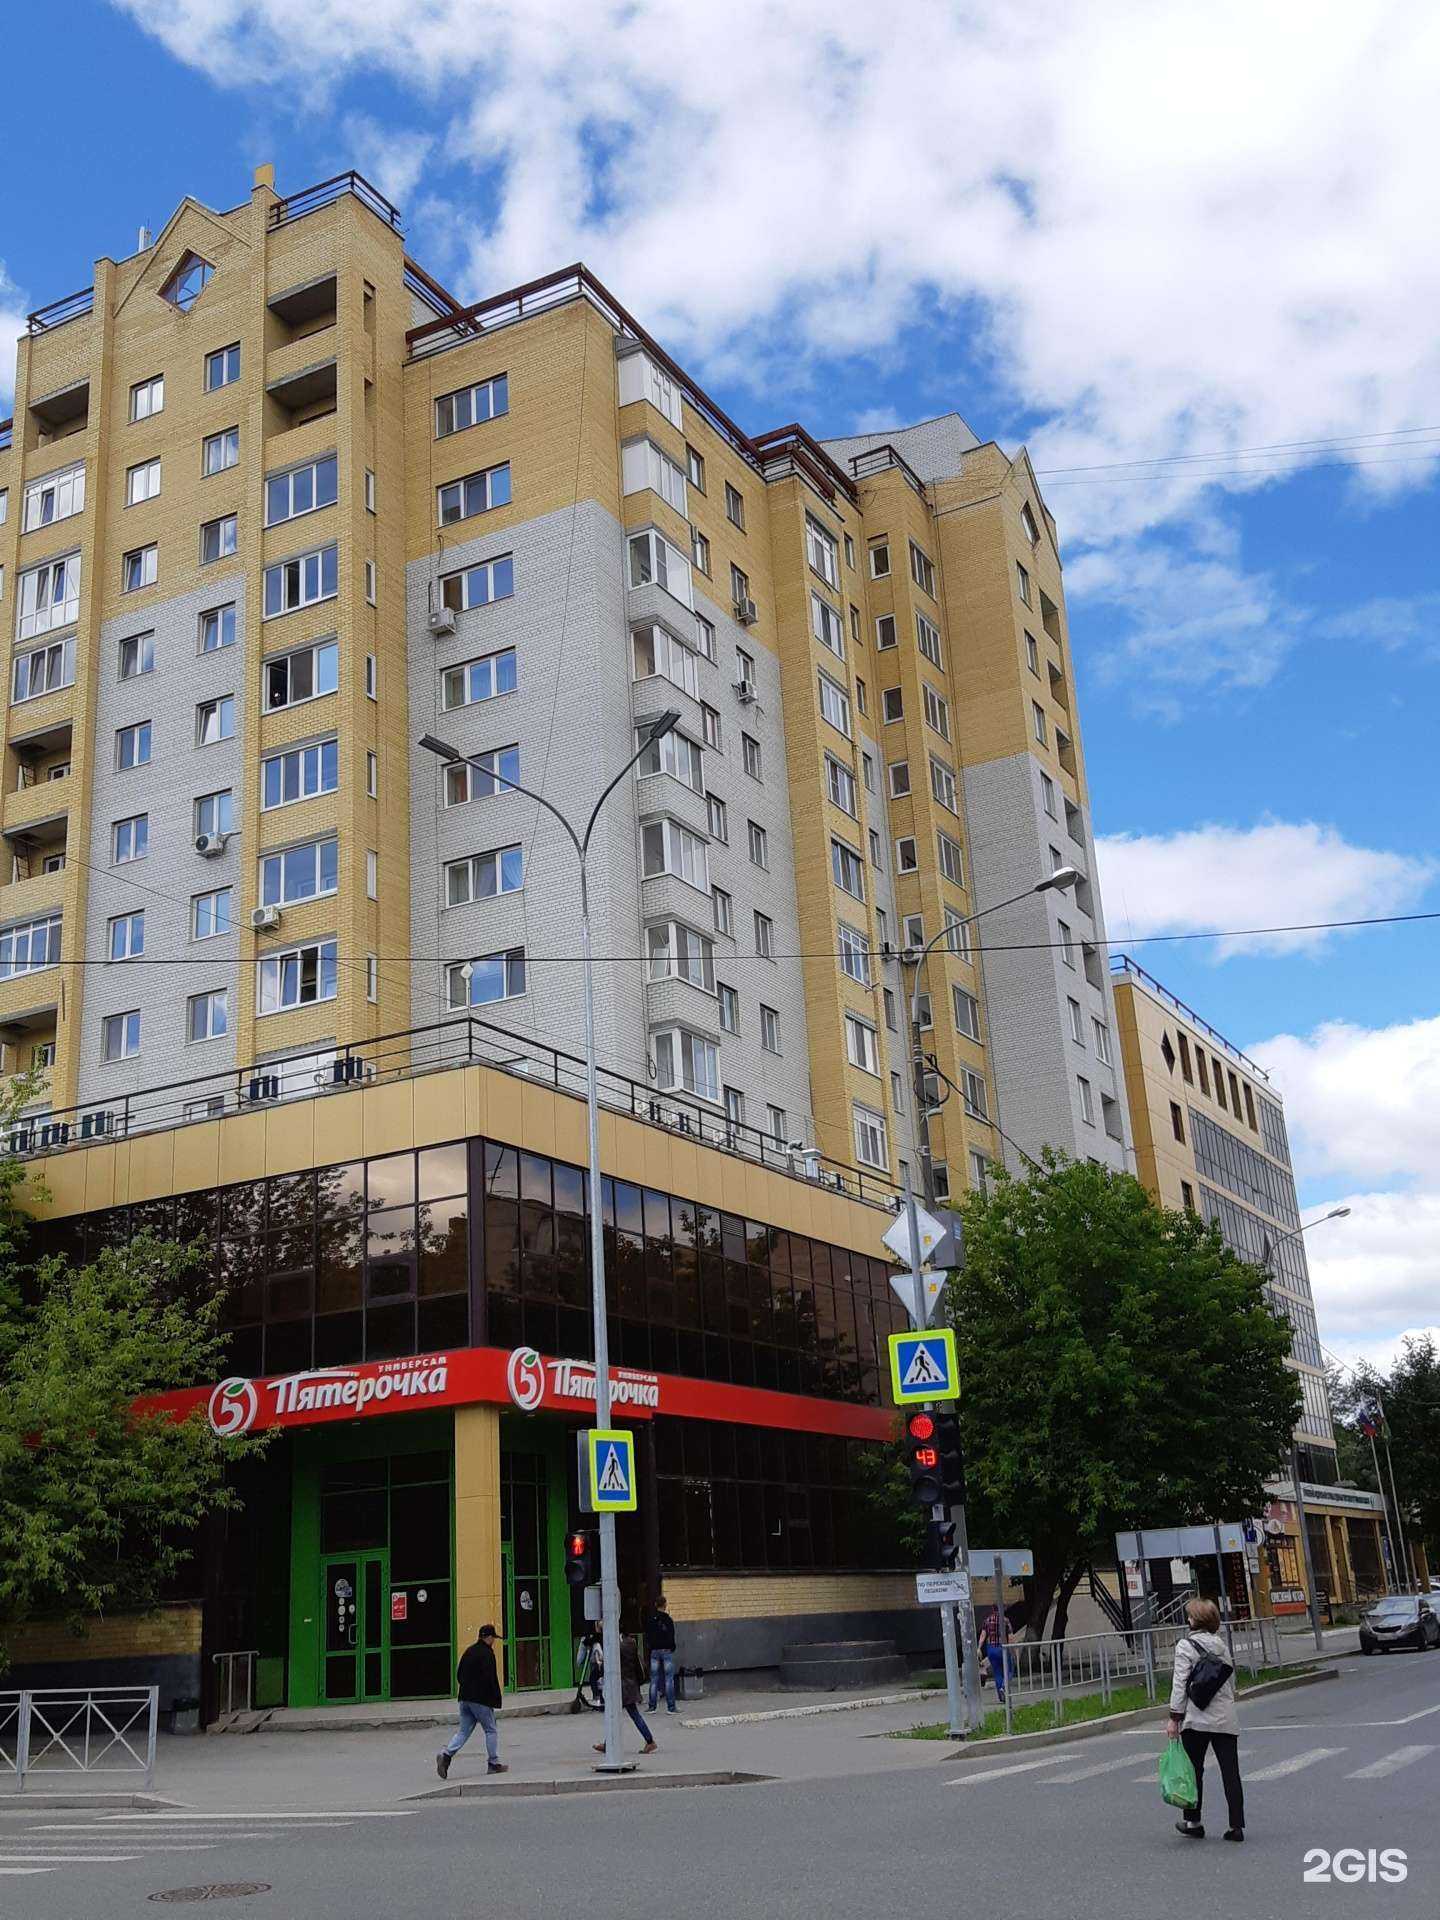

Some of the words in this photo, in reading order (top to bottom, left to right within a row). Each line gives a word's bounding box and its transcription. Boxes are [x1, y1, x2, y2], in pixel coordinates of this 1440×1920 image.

[378, 1355, 448, 1374] УНИВЕРСАМ
[266, 1366, 449, 1414] Пятерочка
[546, 1360, 659, 1408] Пятрочка
[915, 1448, 937, 1466] 43
